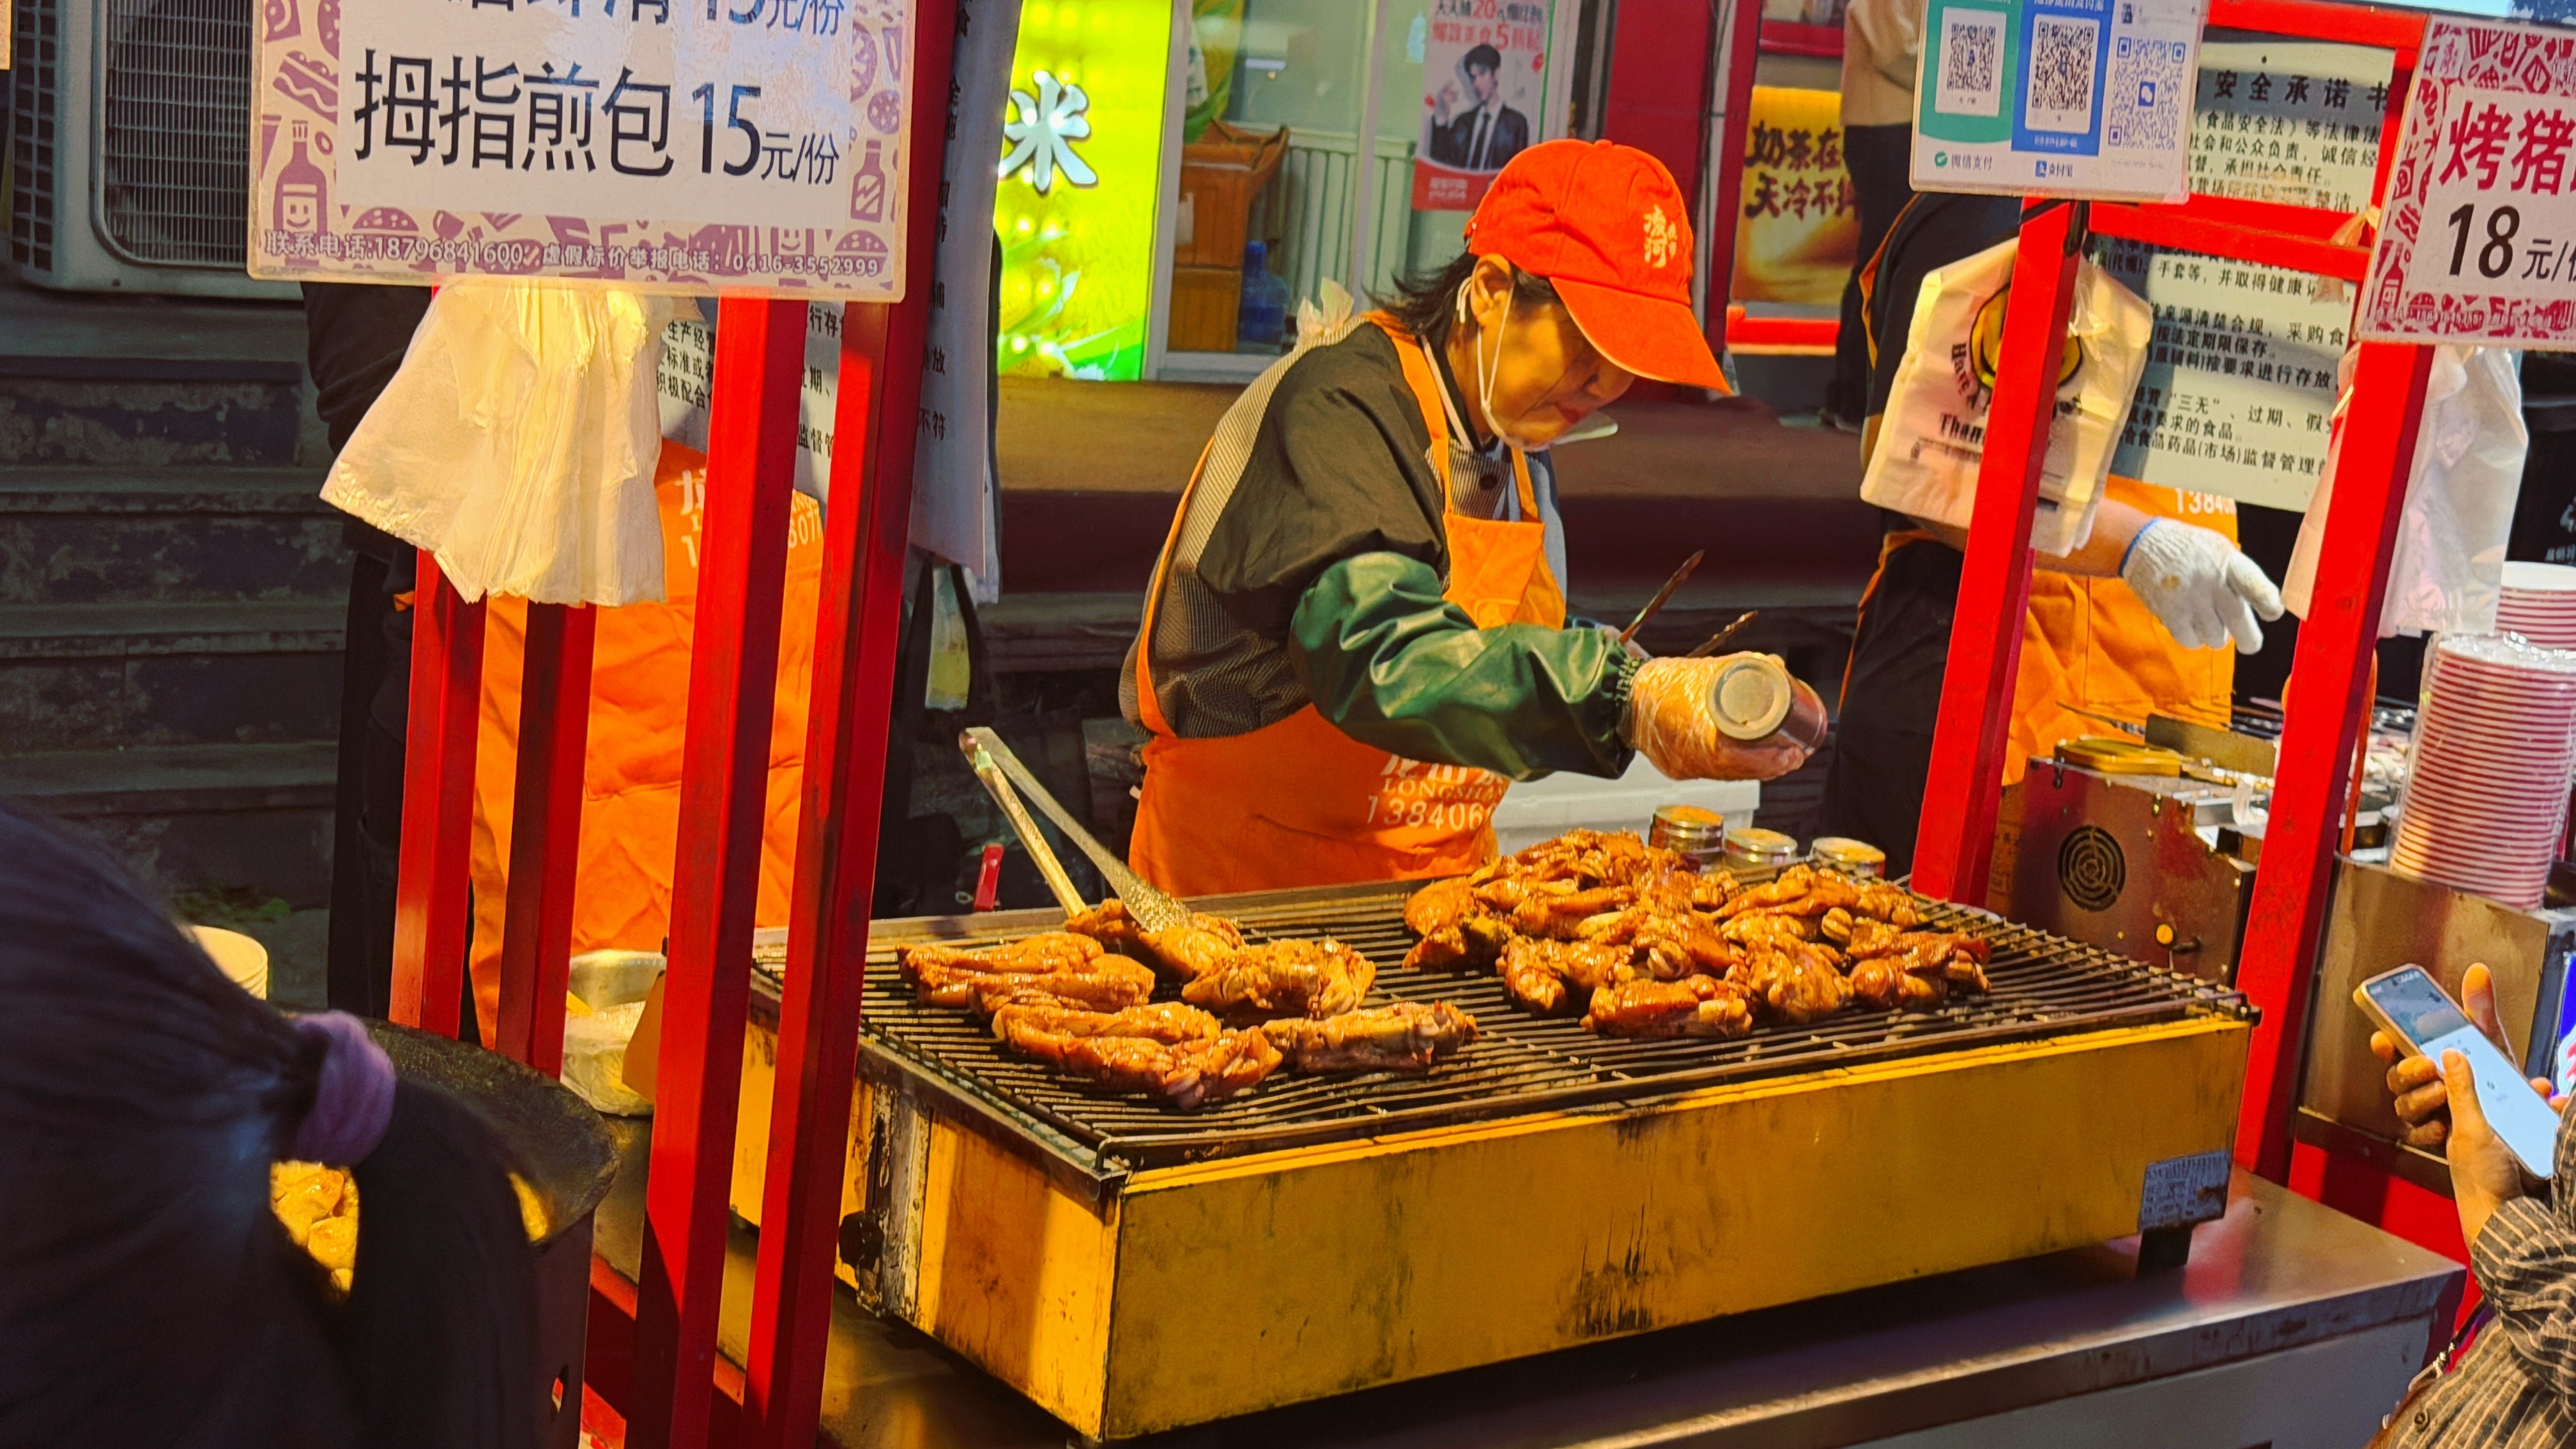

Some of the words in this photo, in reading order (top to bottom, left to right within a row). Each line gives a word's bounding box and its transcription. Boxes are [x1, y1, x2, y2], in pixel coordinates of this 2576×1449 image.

[355, 48, 674, 177] 拇指煎包
[693, 82, 839, 185] 15元/份
[2439, 100, 2576, 195] 烤猪
[660, 345, 714, 382] 标准或
[802, 365, 831, 397] 期、
[1951, 343, 1970, 397] Have
[656, 369, 713, 410] 积极配合
[1940, 412, 1985, 445] Than
